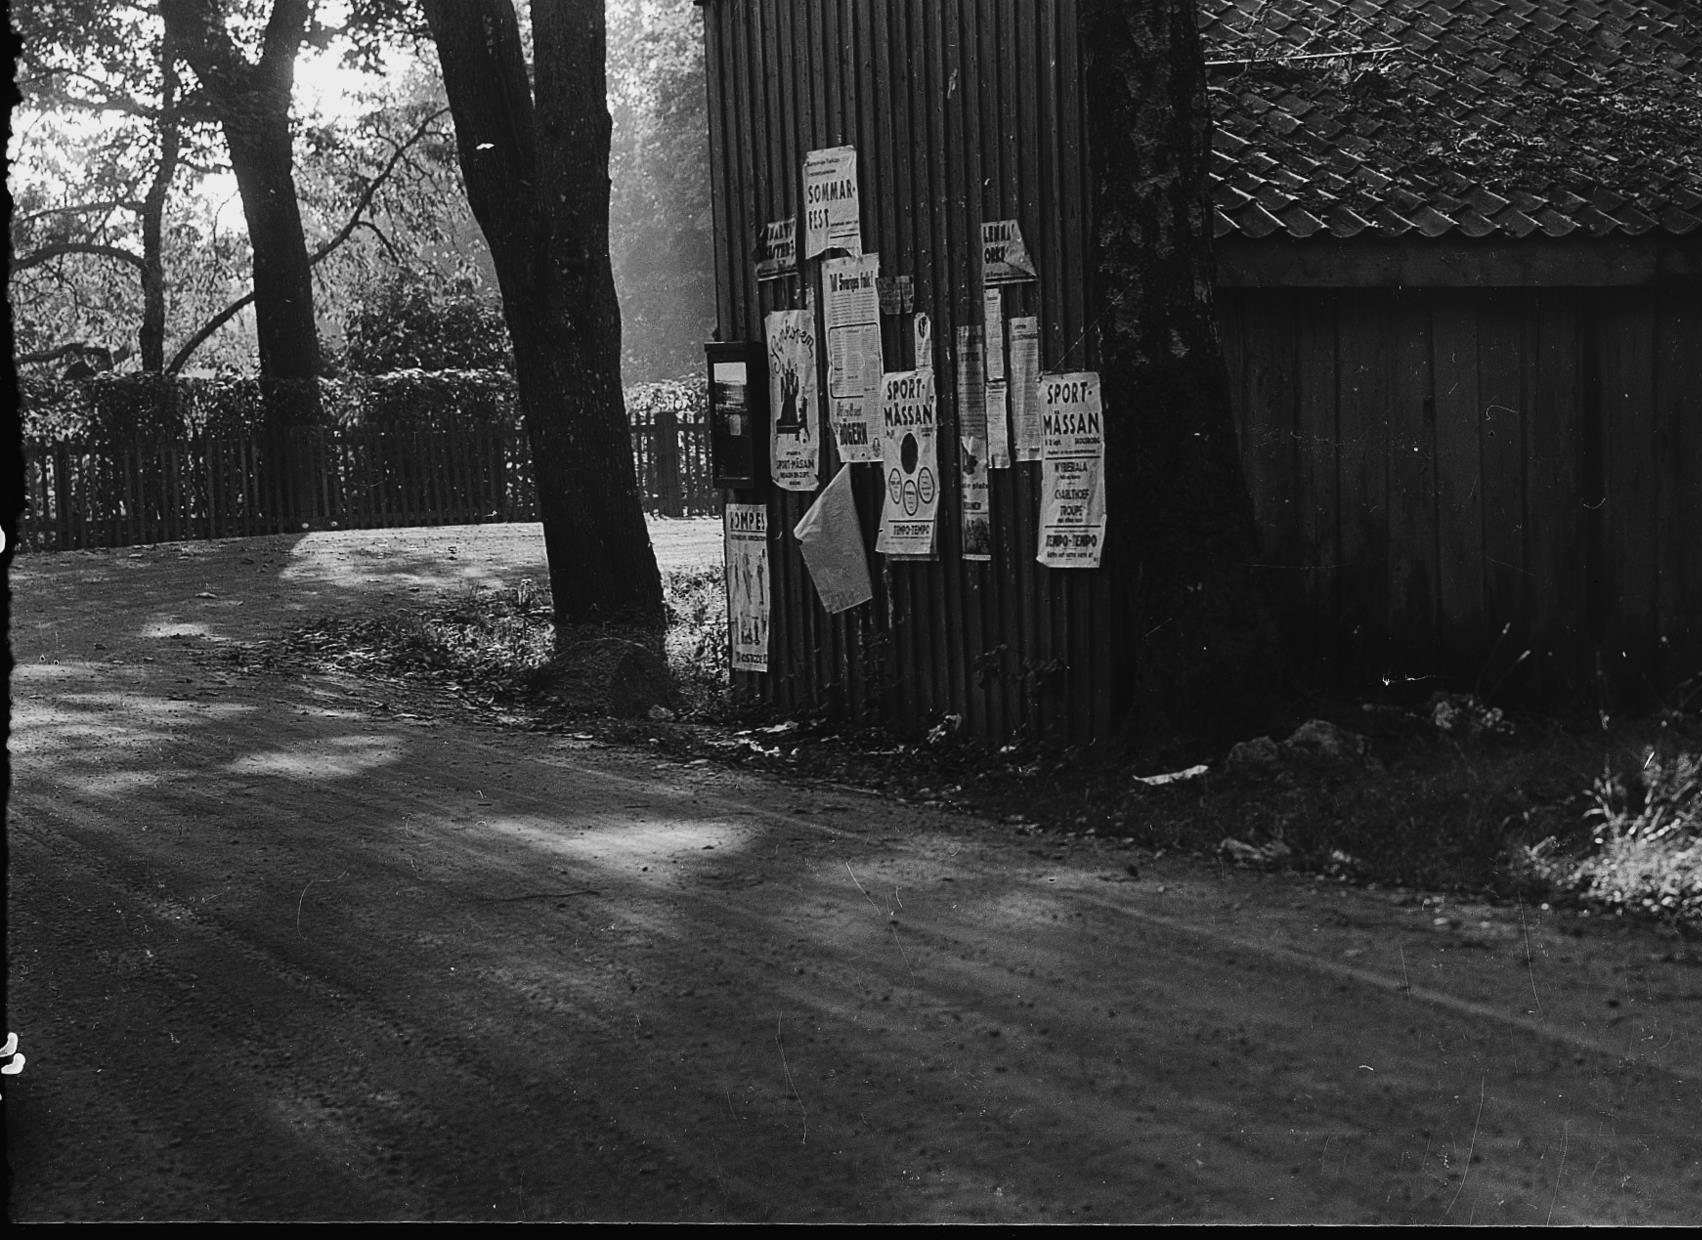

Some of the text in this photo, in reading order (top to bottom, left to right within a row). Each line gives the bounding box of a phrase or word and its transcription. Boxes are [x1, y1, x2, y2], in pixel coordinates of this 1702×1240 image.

[808, 179, 856, 204] SOMMAR-
[809, 208, 829, 230] FEST
[887, 378, 926, 401] SPORT-
[1047, 381, 1093, 405] SPORT-
[884, 402, 933, 428] MÄSSAN
[1043, 409, 1100, 436] MÄSSAN
